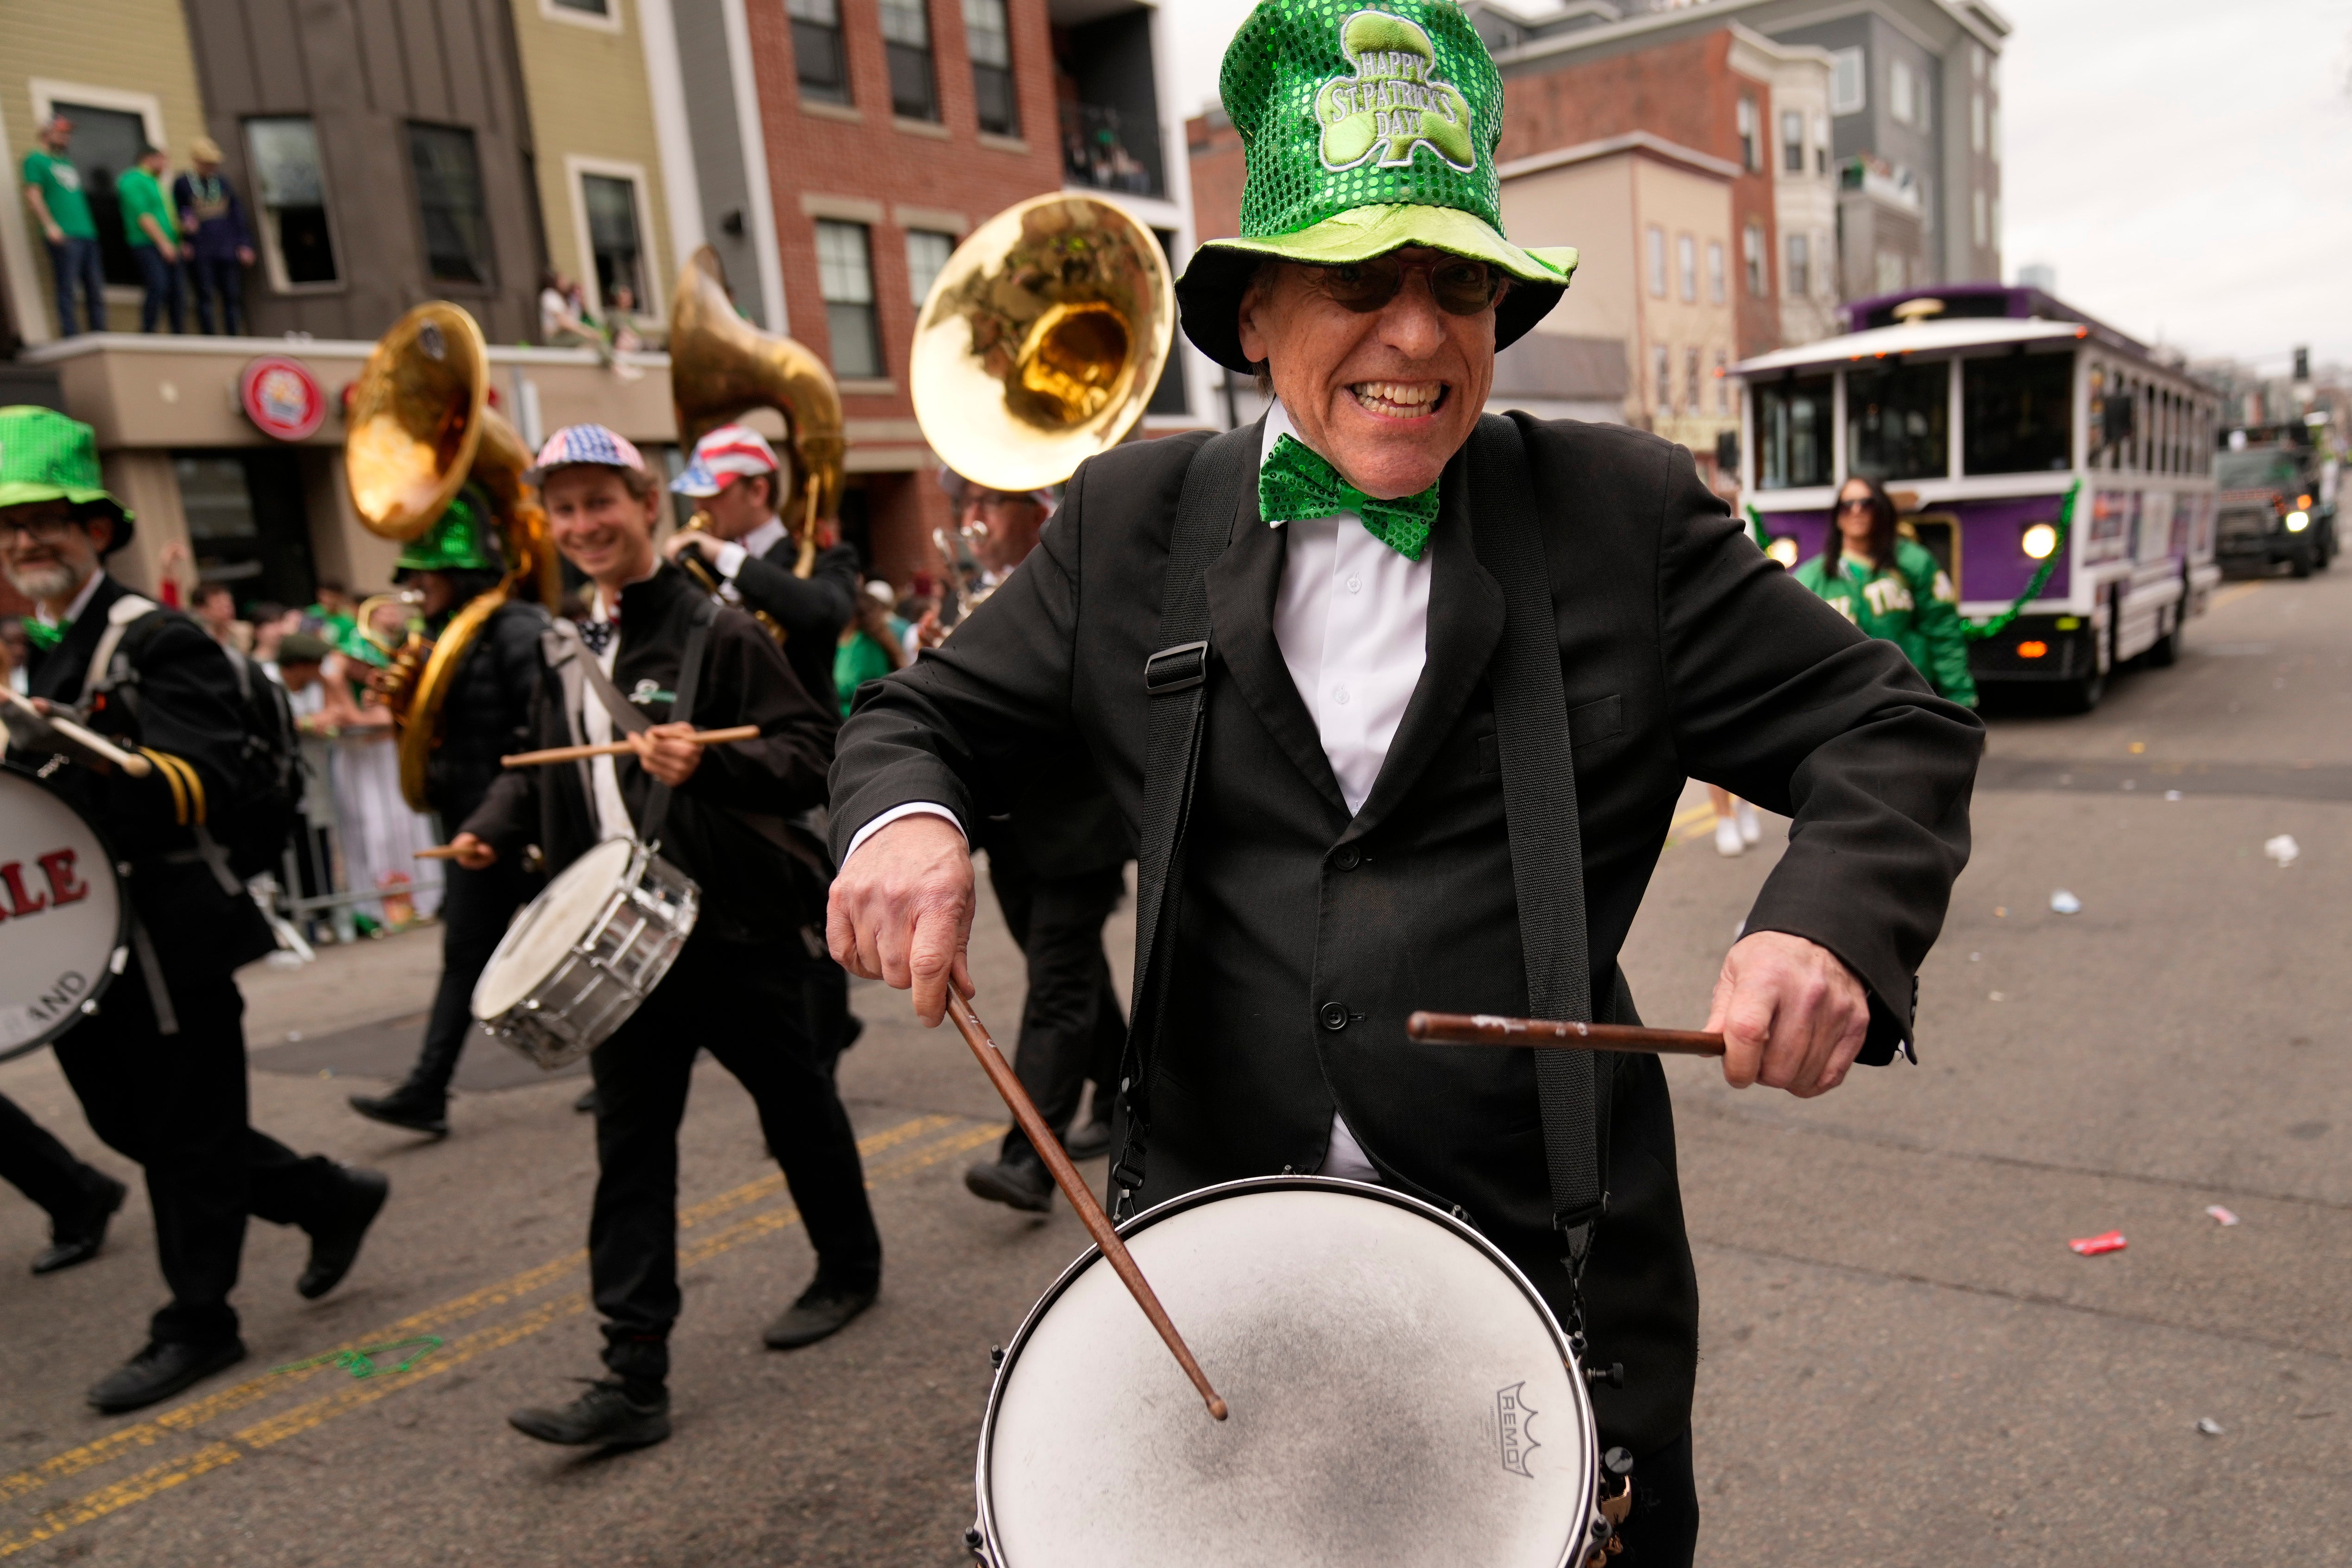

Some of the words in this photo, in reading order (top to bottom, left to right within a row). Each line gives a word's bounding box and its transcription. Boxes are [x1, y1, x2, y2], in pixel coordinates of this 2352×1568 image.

[1360, 51, 1424, 79] HAPPY
[1375, 109, 1422, 138] DAY!
[0, 846, 88, 922] LE
[1502, 1395, 1519, 1463] REMO
